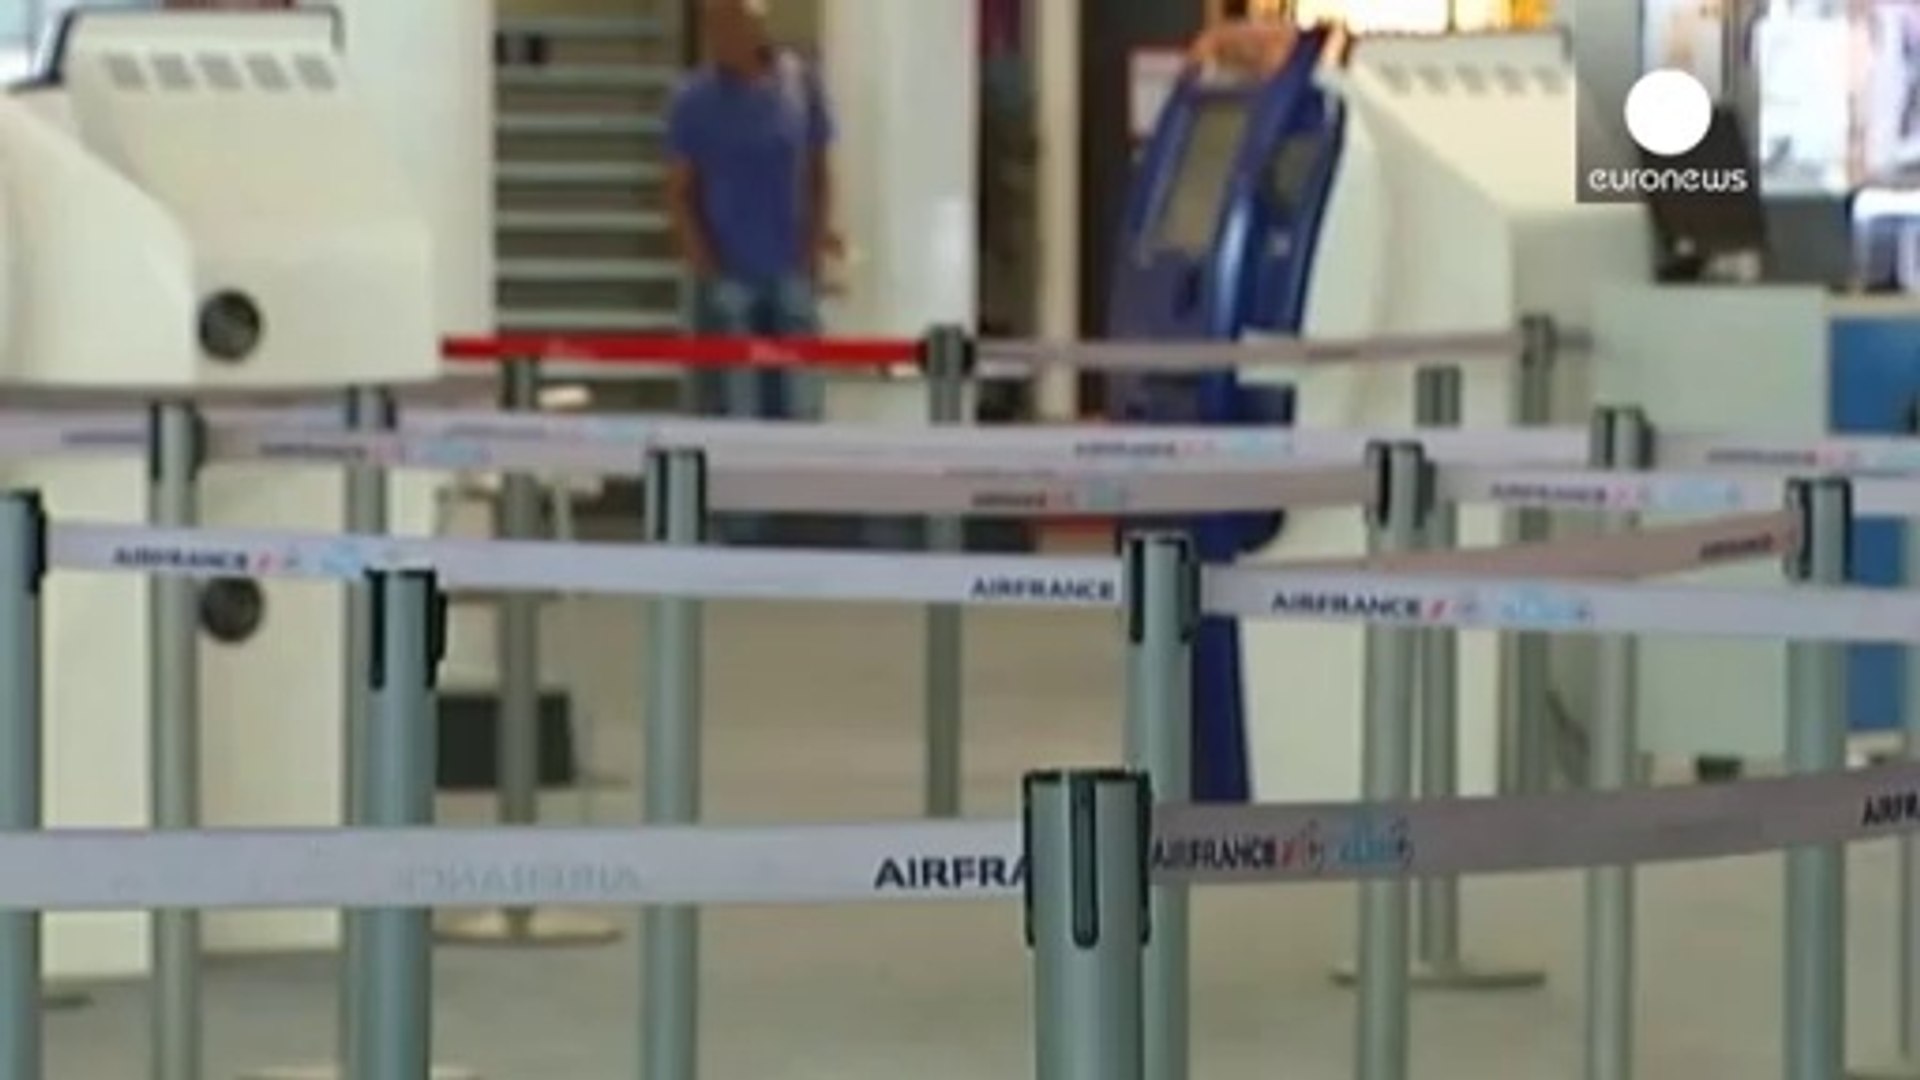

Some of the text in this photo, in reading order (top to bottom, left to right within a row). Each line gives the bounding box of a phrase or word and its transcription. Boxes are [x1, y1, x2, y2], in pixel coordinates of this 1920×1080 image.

[971, 577, 1114, 600] AIRFRANCE
[1271, 592, 1421, 616] AIRFRANCE
[1151, 836, 1277, 870] AIRFRANCE
